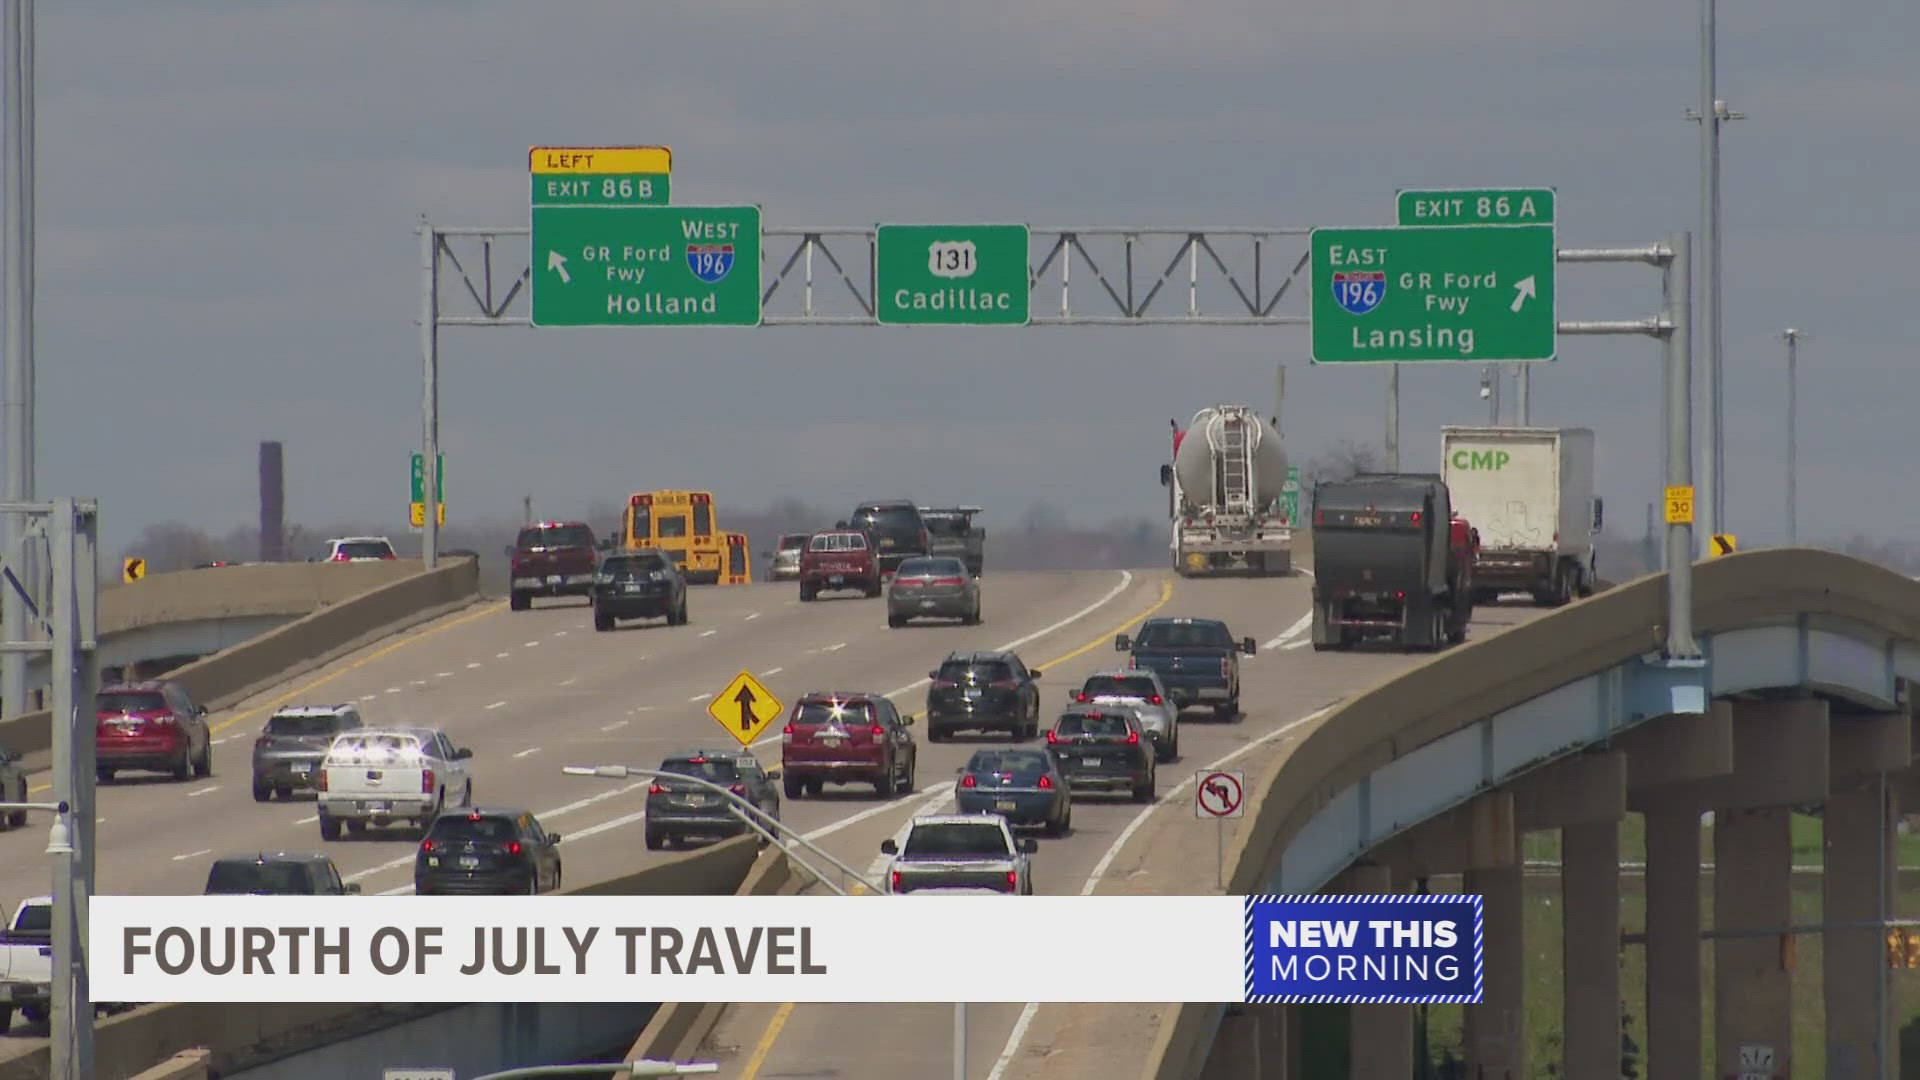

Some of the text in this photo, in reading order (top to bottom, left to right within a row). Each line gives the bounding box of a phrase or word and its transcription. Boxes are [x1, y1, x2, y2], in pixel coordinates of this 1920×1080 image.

[547, 154, 594, 168] LEFT
[547, 181, 591, 197] EXIT
[1415, 197, 1536, 217] EXIT 86 A
[682, 220, 739, 239] WEST
[583, 245, 670, 261] GR Ford
[936, 249, 969, 270] 131
[1329, 245, 1387, 265] EAST
[697, 253, 724, 275] 196
[606, 267, 645, 284] Fwy
[1399, 271, 1497, 289] GR Ford
[607, 294, 716, 314] Holland
[895, 289, 1010, 310] Cadillac
[1342, 282, 1376, 306] 196
[1425, 295, 1469, 315] Fwy
[1352, 324, 1475, 353] Lansing
[1452, 450, 1510, 471] CMP
[1670, 501, 1689, 513] 30
